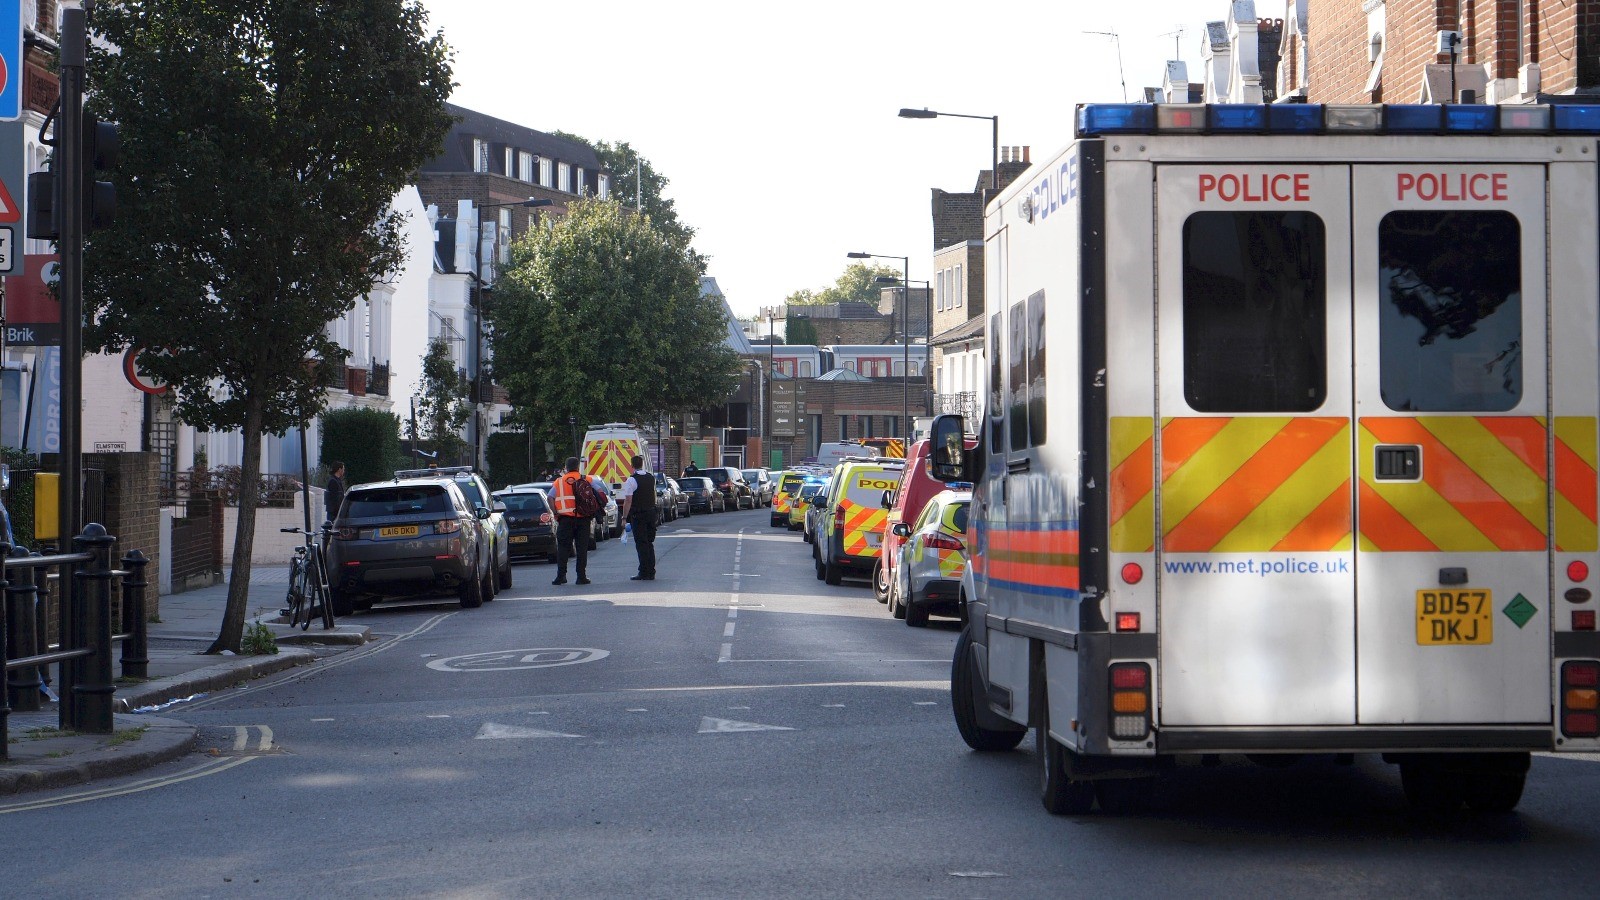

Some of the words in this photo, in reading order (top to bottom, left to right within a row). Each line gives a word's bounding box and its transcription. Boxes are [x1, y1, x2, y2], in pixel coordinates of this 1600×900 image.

[1032, 155, 1077, 220] POLICE
[1199, 173, 1310, 202] POLICE
[1397, 172, 1508, 201] POLICE
[7, 327, 34, 341] Brik
[1164, 558, 1349, 577] www.met.police.uk
[1422, 592, 1487, 615] BD57
[1431, 619, 1479, 641] DKJ
